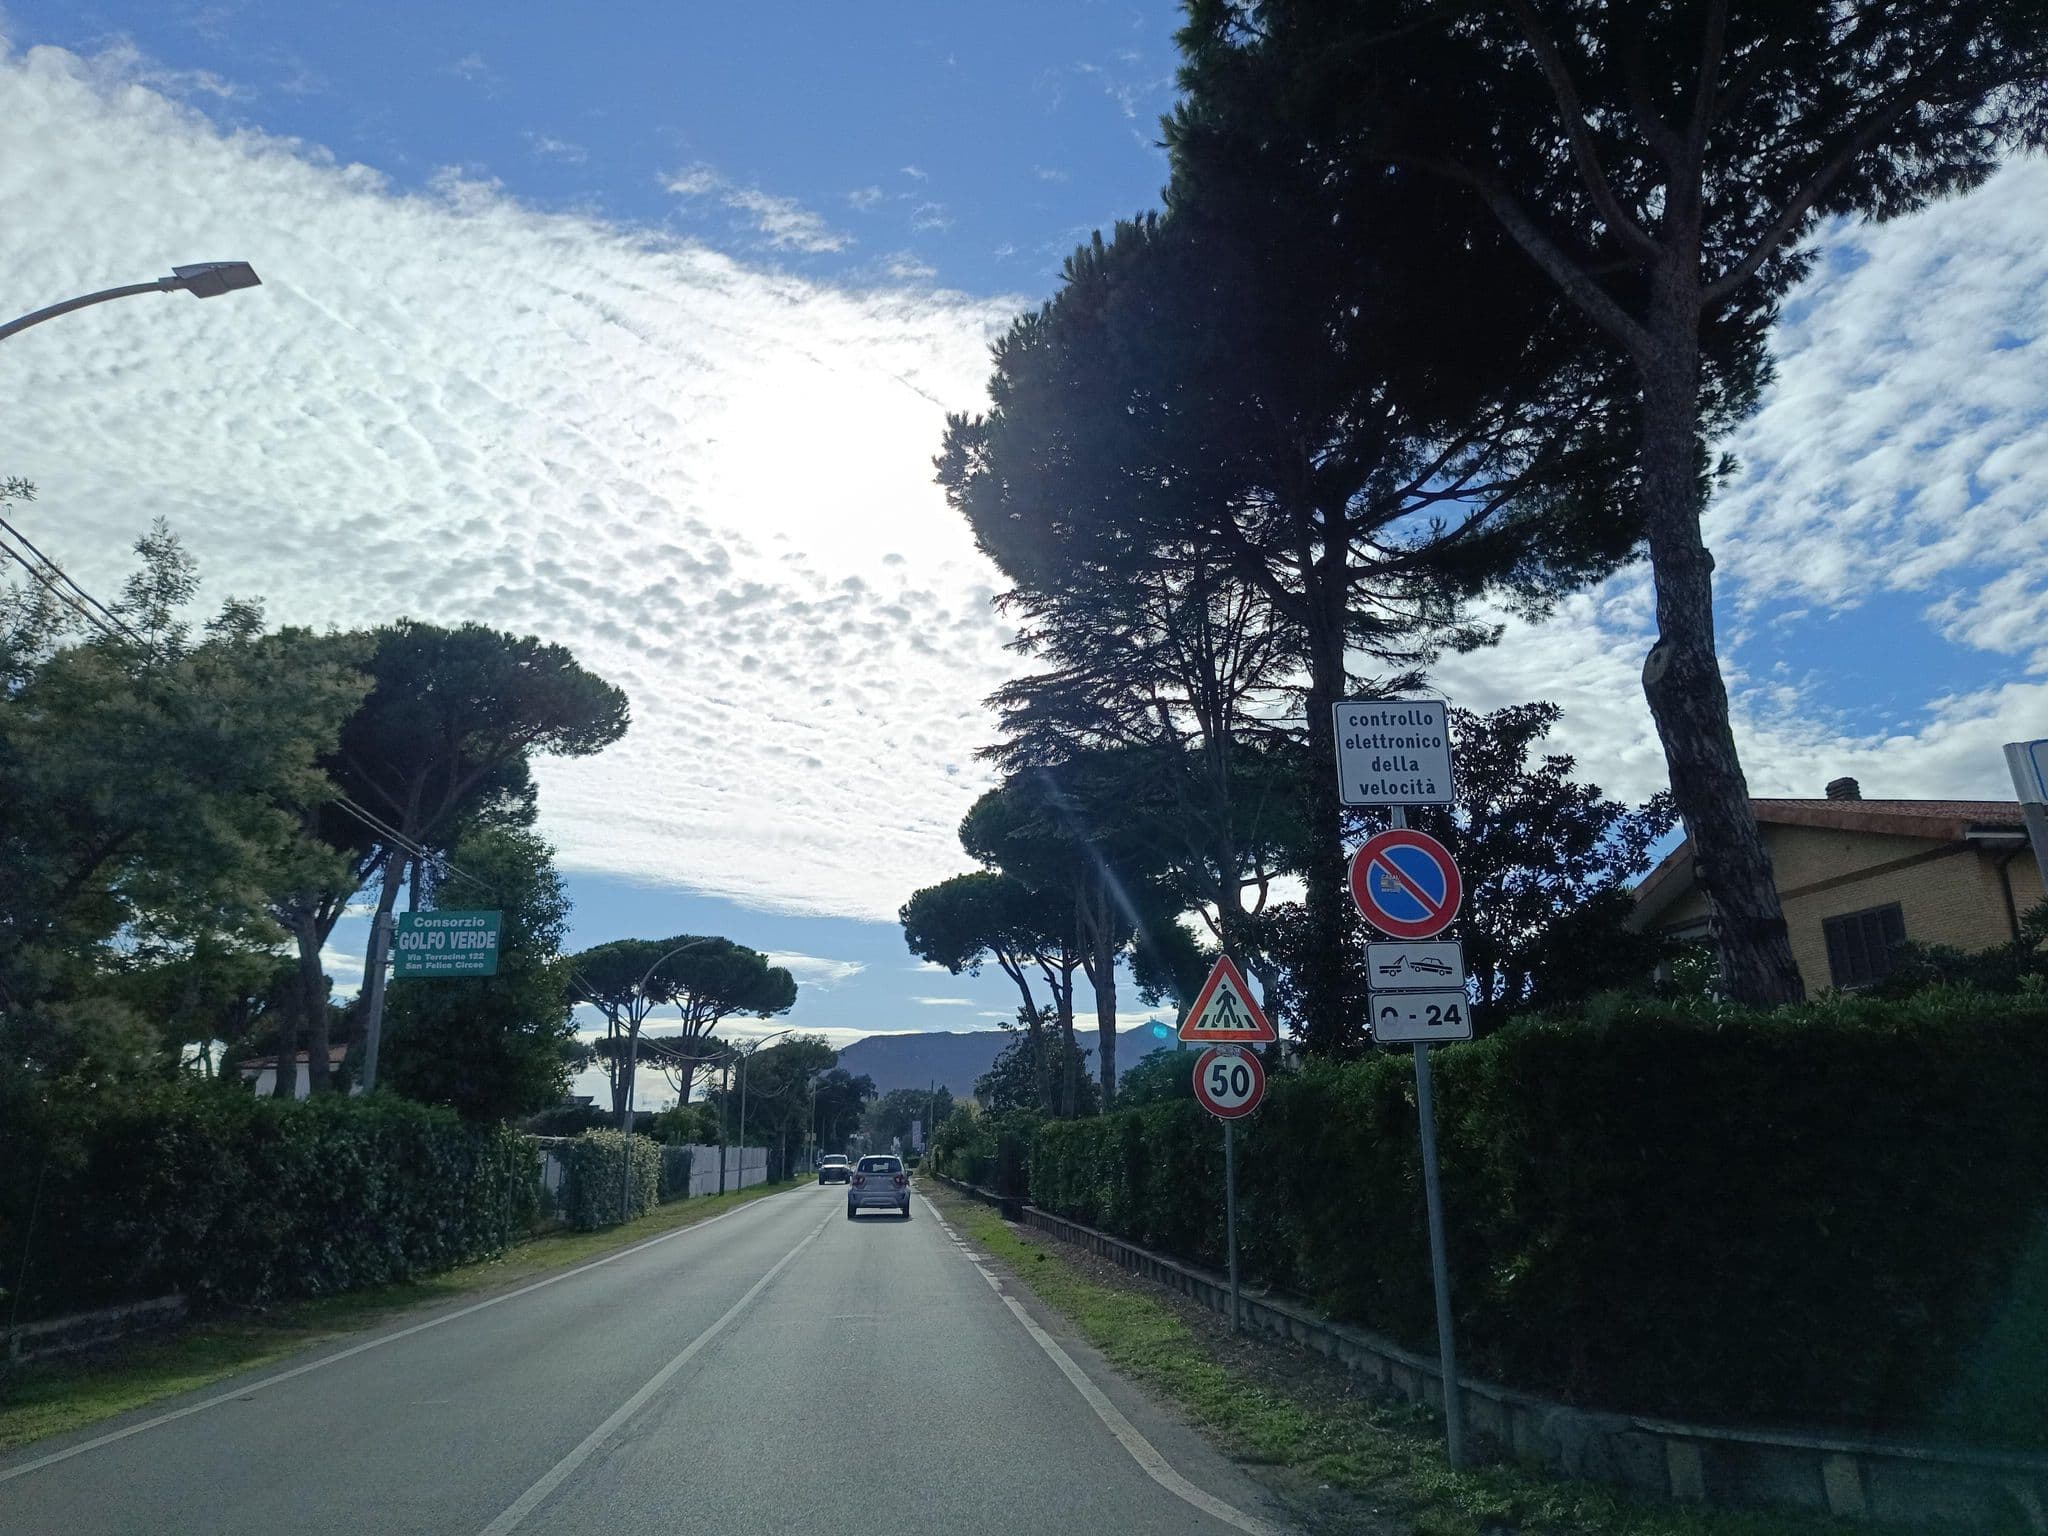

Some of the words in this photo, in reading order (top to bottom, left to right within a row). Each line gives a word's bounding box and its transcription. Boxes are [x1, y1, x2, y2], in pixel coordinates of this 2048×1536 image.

[1349, 709, 1433, 728] controllo
[1345, 732, 1441, 750] elettronico
[1371, 755, 1420, 772] della
[1359, 778, 1436, 796] velocità
[413, 916, 486, 928] Consorzio
[398, 931, 446, 950] GOLFO
[450, 930, 497, 949] VERDE
[407, 953, 422, 961] Via
[468, 952, 485, 960] 122
[405, 962, 422, 970] San
[1425, 1004, 1463, 1026] 24
[1210, 1064, 1250, 1098] 50
